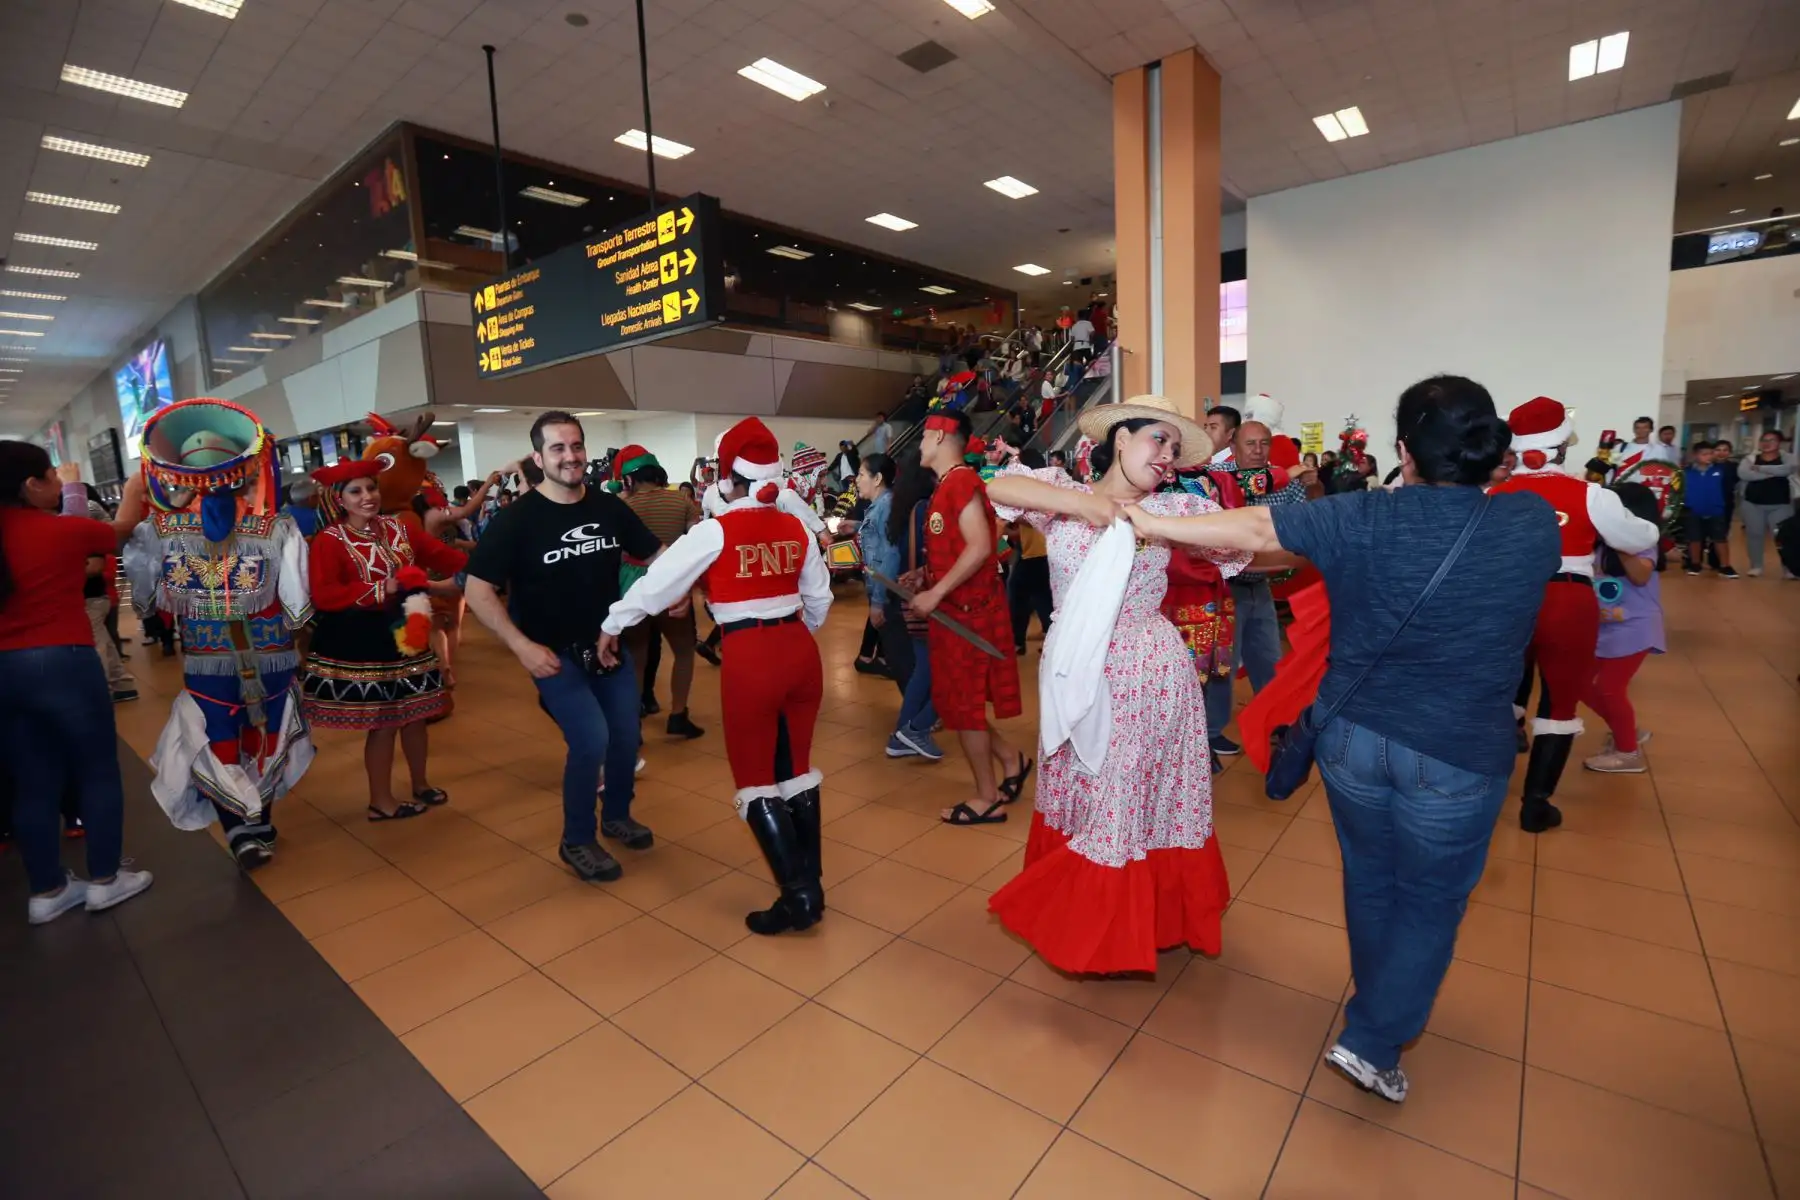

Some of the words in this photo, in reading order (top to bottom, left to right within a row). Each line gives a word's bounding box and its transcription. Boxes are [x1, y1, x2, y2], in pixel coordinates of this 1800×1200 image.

[586, 234, 623, 258] Transporte
[623, 220, 657, 243] Terrestre
[597, 252, 617, 269] Ground
[615, 264, 640, 285] Sanidad
[640, 260, 659, 277] Aérea
[642, 277, 659, 291] Center
[601, 309, 627, 327] Llegadas
[627, 298, 662, 318] Nacionales
[620, 320, 643, 337] Domestic
[643, 315, 662, 330] Arrivals
[543, 536, 620, 564] O'NEILL
[735, 540, 802, 578] PNP
